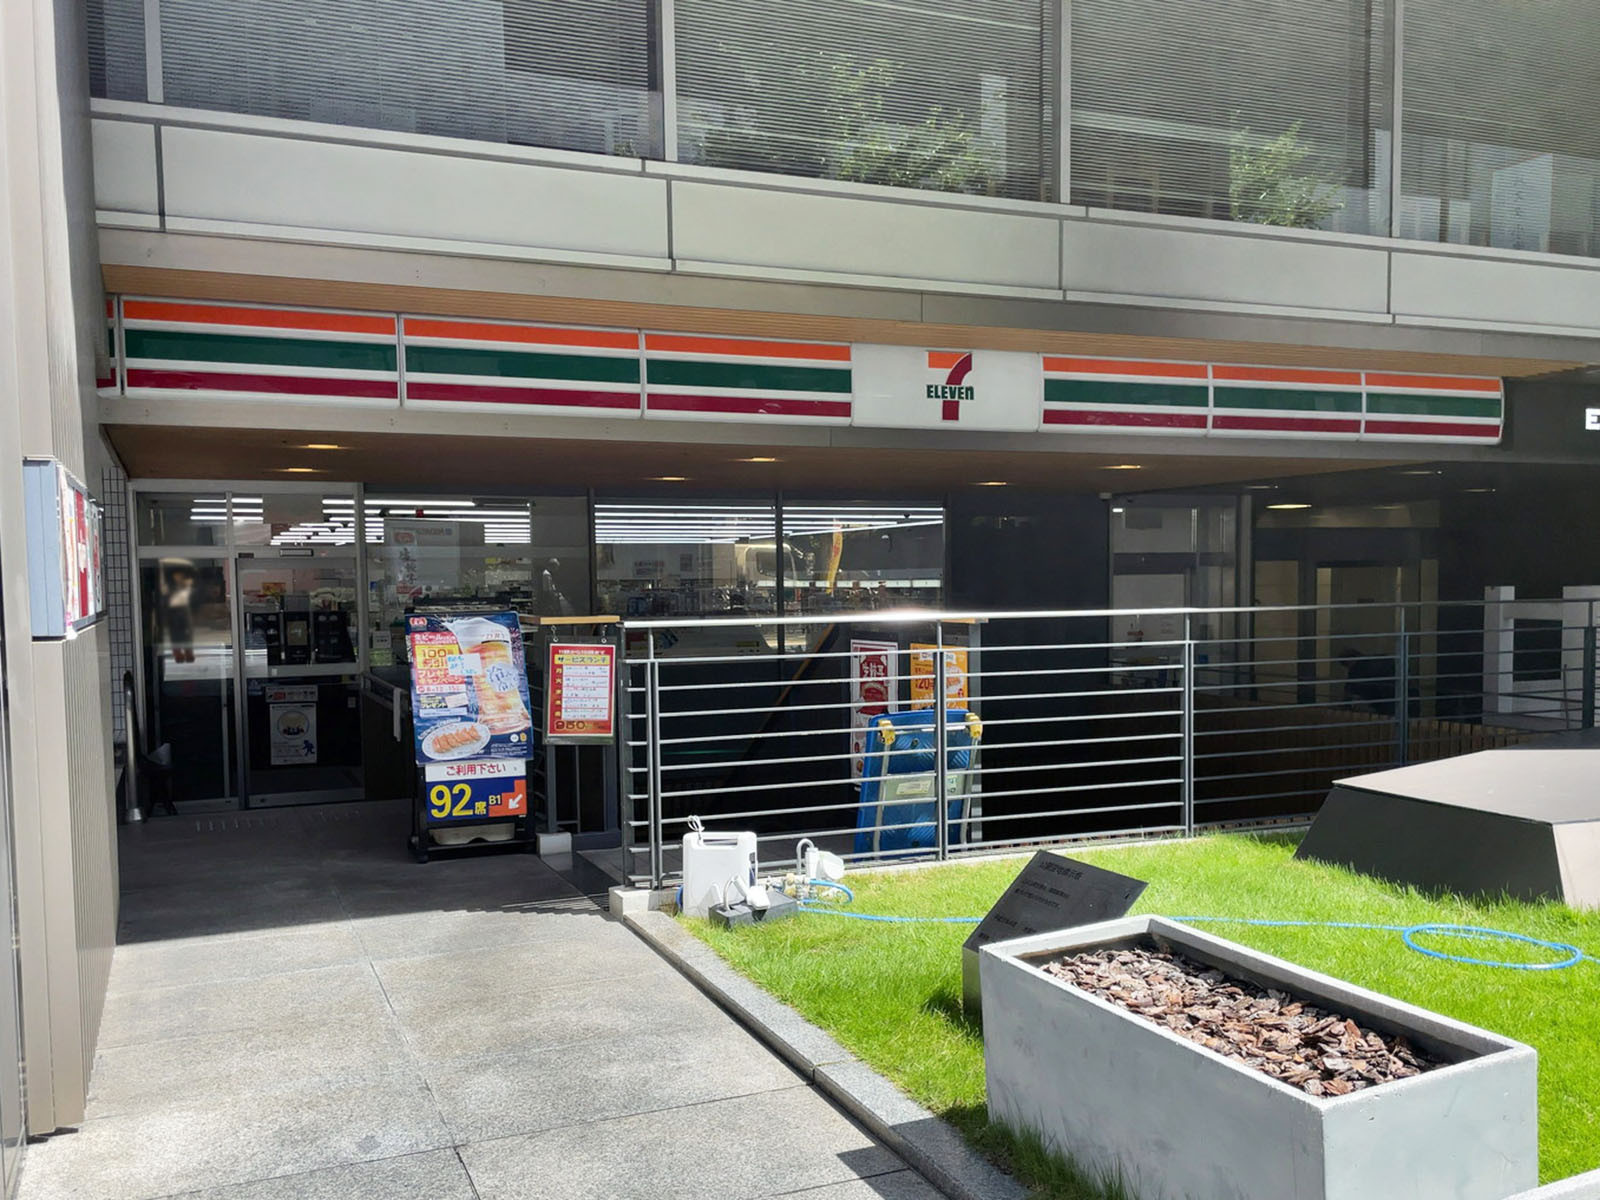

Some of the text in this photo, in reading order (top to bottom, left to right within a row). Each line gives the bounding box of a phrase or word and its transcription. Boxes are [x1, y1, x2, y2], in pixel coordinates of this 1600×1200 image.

[446, 763, 506, 776] ご利用下さい
[488, 795, 501, 805] B1
